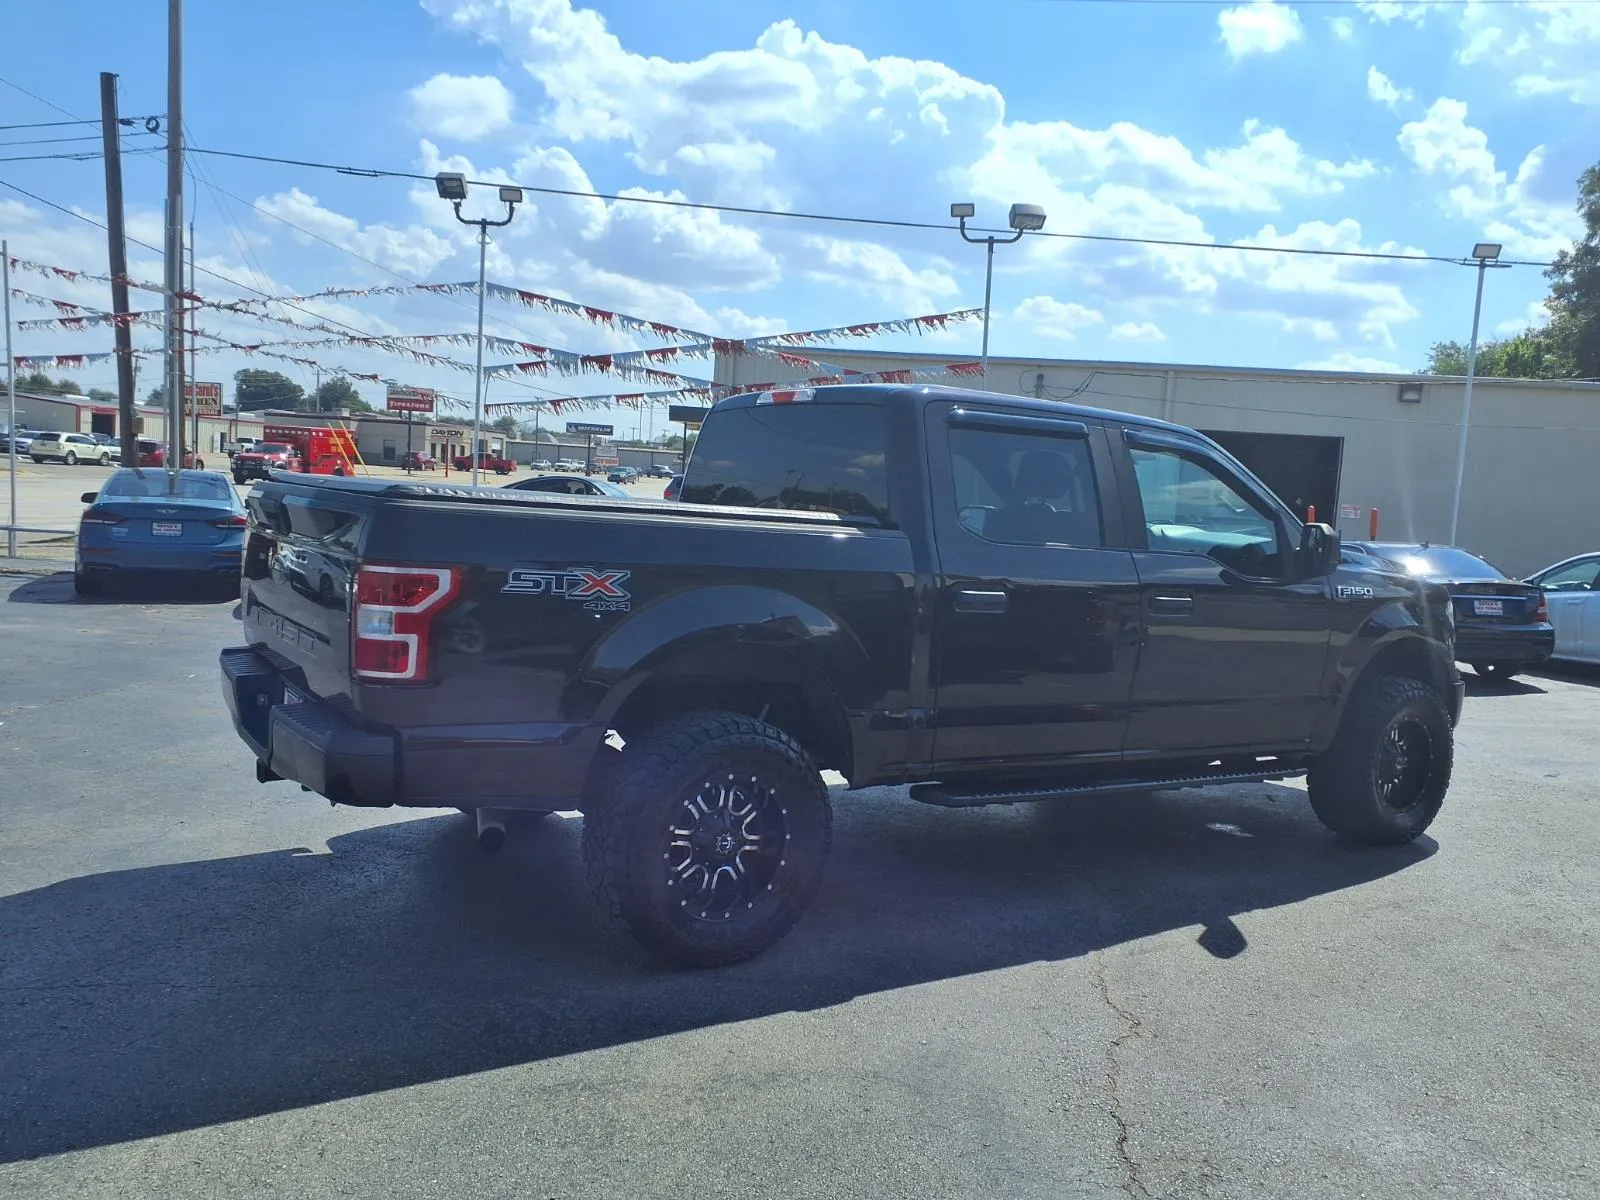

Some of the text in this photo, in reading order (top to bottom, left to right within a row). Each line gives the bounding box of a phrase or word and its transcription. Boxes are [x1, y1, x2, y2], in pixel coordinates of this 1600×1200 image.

[389, 400, 430, 409] Firestone
[430, 429, 464, 437] DAYTON
[500, 568, 632, 601] STX
